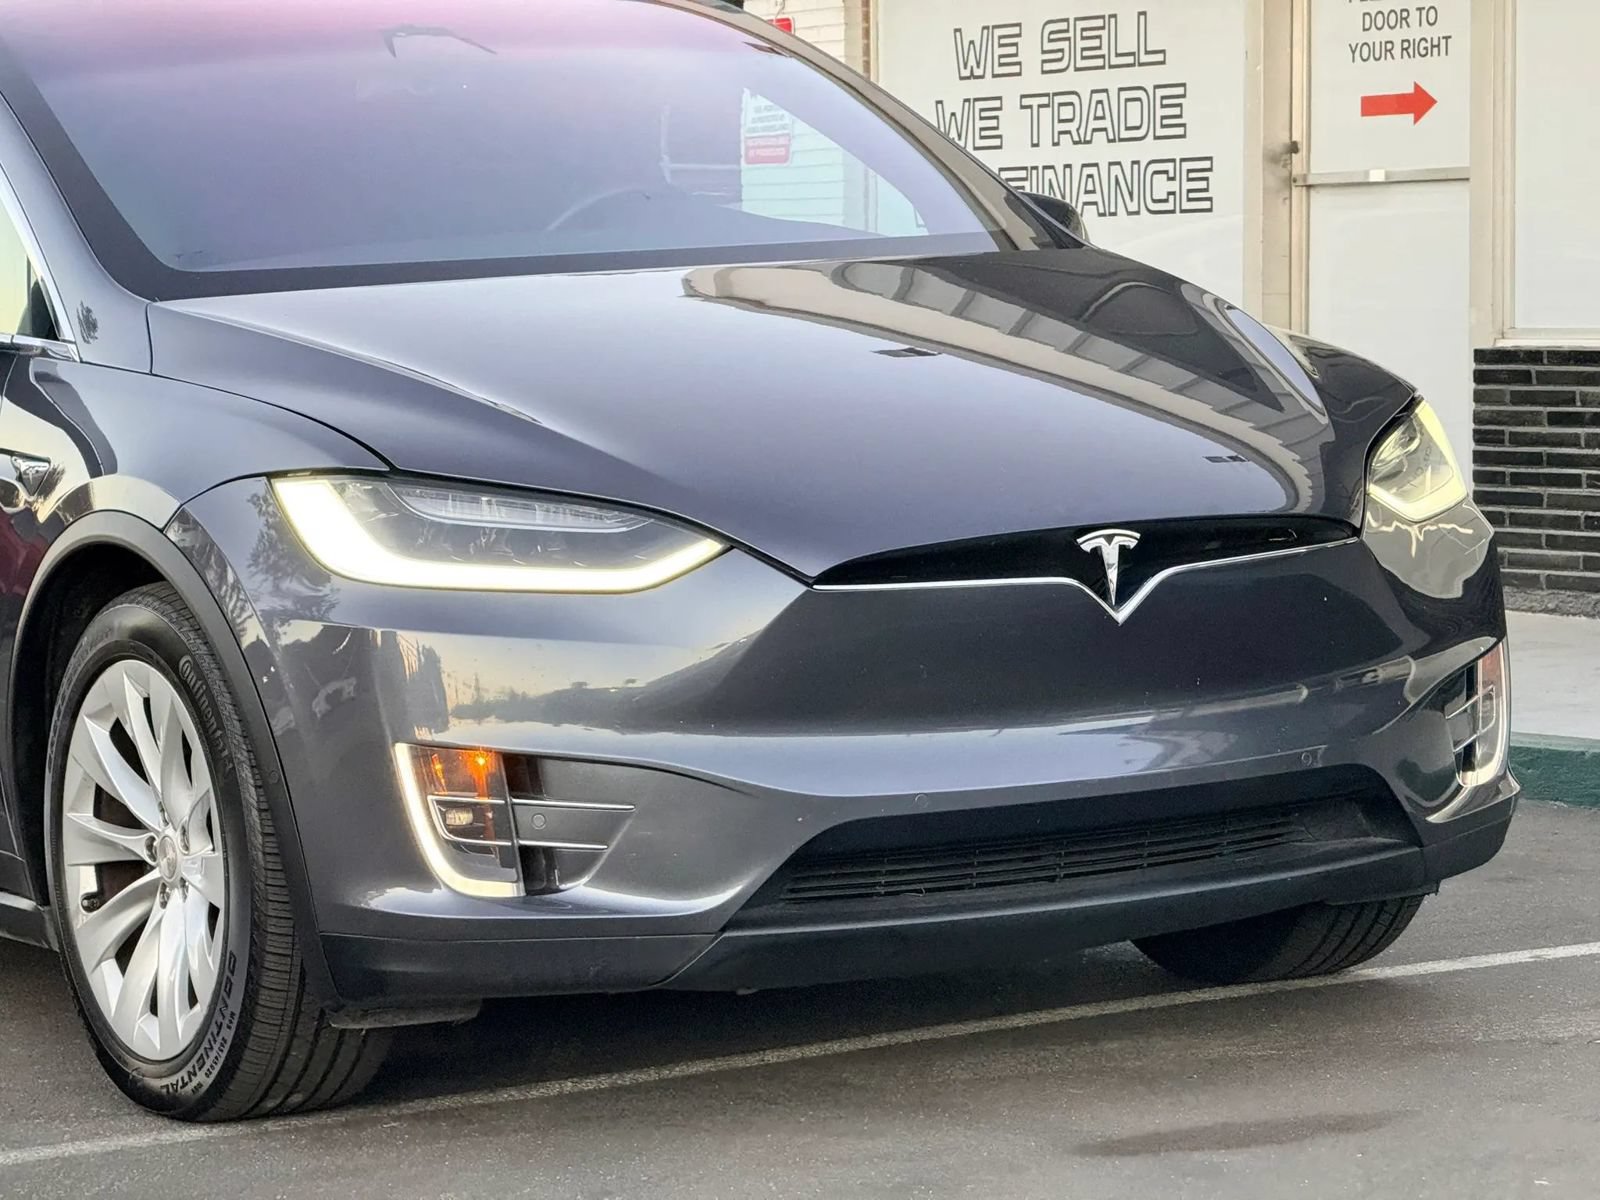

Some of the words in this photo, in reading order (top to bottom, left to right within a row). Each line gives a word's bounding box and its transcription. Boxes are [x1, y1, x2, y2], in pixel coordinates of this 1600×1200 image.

[1362, 8, 1410, 32] DOOR
[1415, 5, 1438, 27] TO
[953, 22, 1022, 80] WE
[1040, 11, 1166, 75] SELL
[1348, 40, 1395, 63] YOUR
[1400, 35, 1452, 59] RIGHT
[935, 96, 1003, 151] WE
[1019, 82, 1187, 147] TRADE
